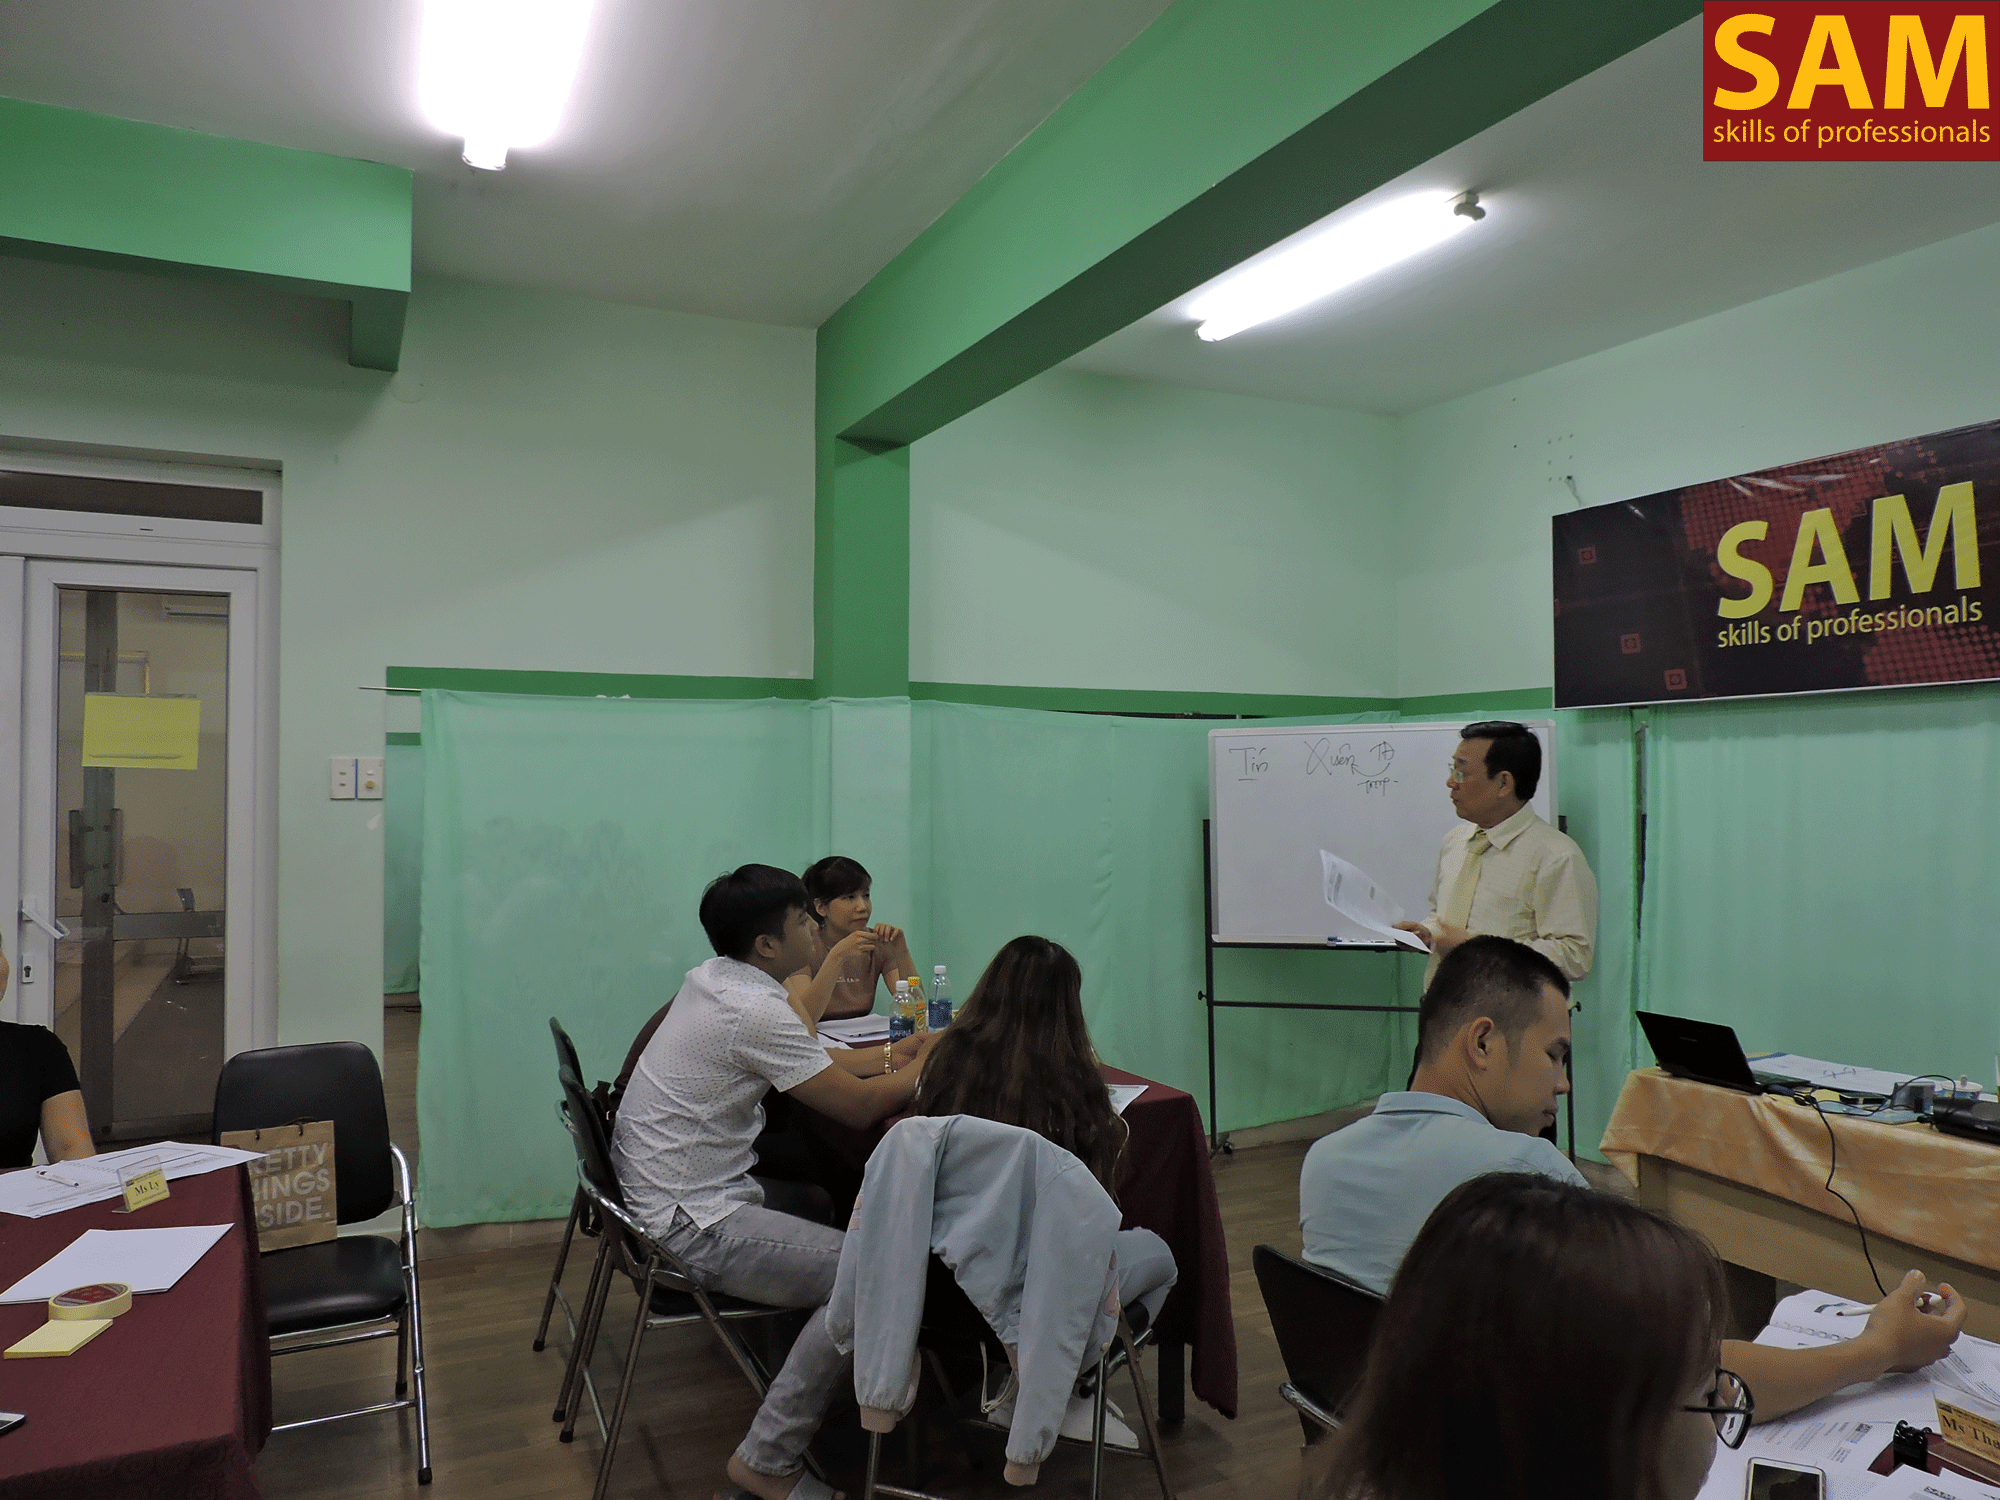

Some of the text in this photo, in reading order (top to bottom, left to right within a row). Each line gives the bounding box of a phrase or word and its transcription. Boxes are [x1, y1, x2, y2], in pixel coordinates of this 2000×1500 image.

[1717, 481, 1981, 619] SAM
[1718, 595, 1983, 648] skills of professionals
[134, 1184, 148, 1197] Ms
[254, 1196, 331, 1228] SIDE.
[1941, 1414, 1966, 1434] Ms
